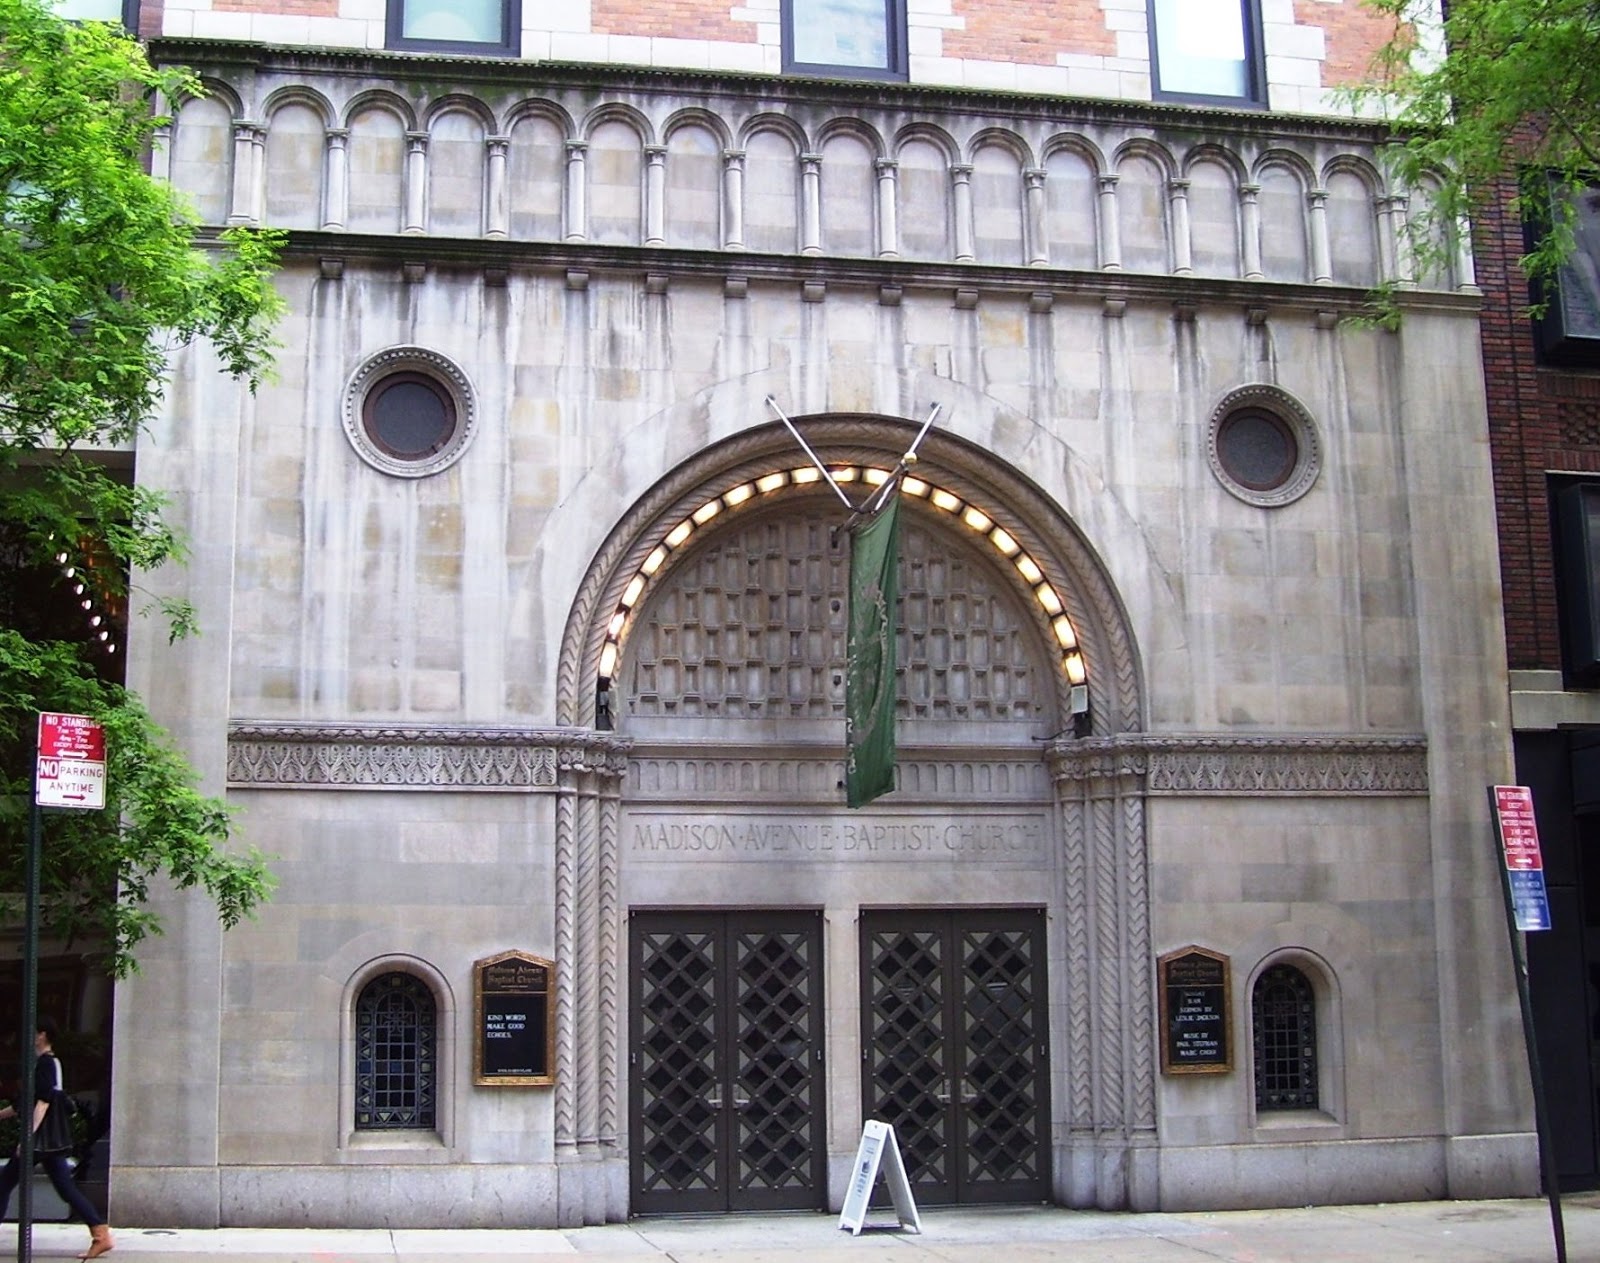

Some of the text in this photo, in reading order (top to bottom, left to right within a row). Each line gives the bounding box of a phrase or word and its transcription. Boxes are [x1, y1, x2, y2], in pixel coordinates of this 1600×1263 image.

[45, 715, 58, 726] NO
[40, 760, 103, 778] NO PARKING
[49, 781, 94, 793] ANYTIME
[1498, 791, 1506, 800] NO
[632, 824, 1039, 851] MADISON AVENUE BAPTIST CHURCH
